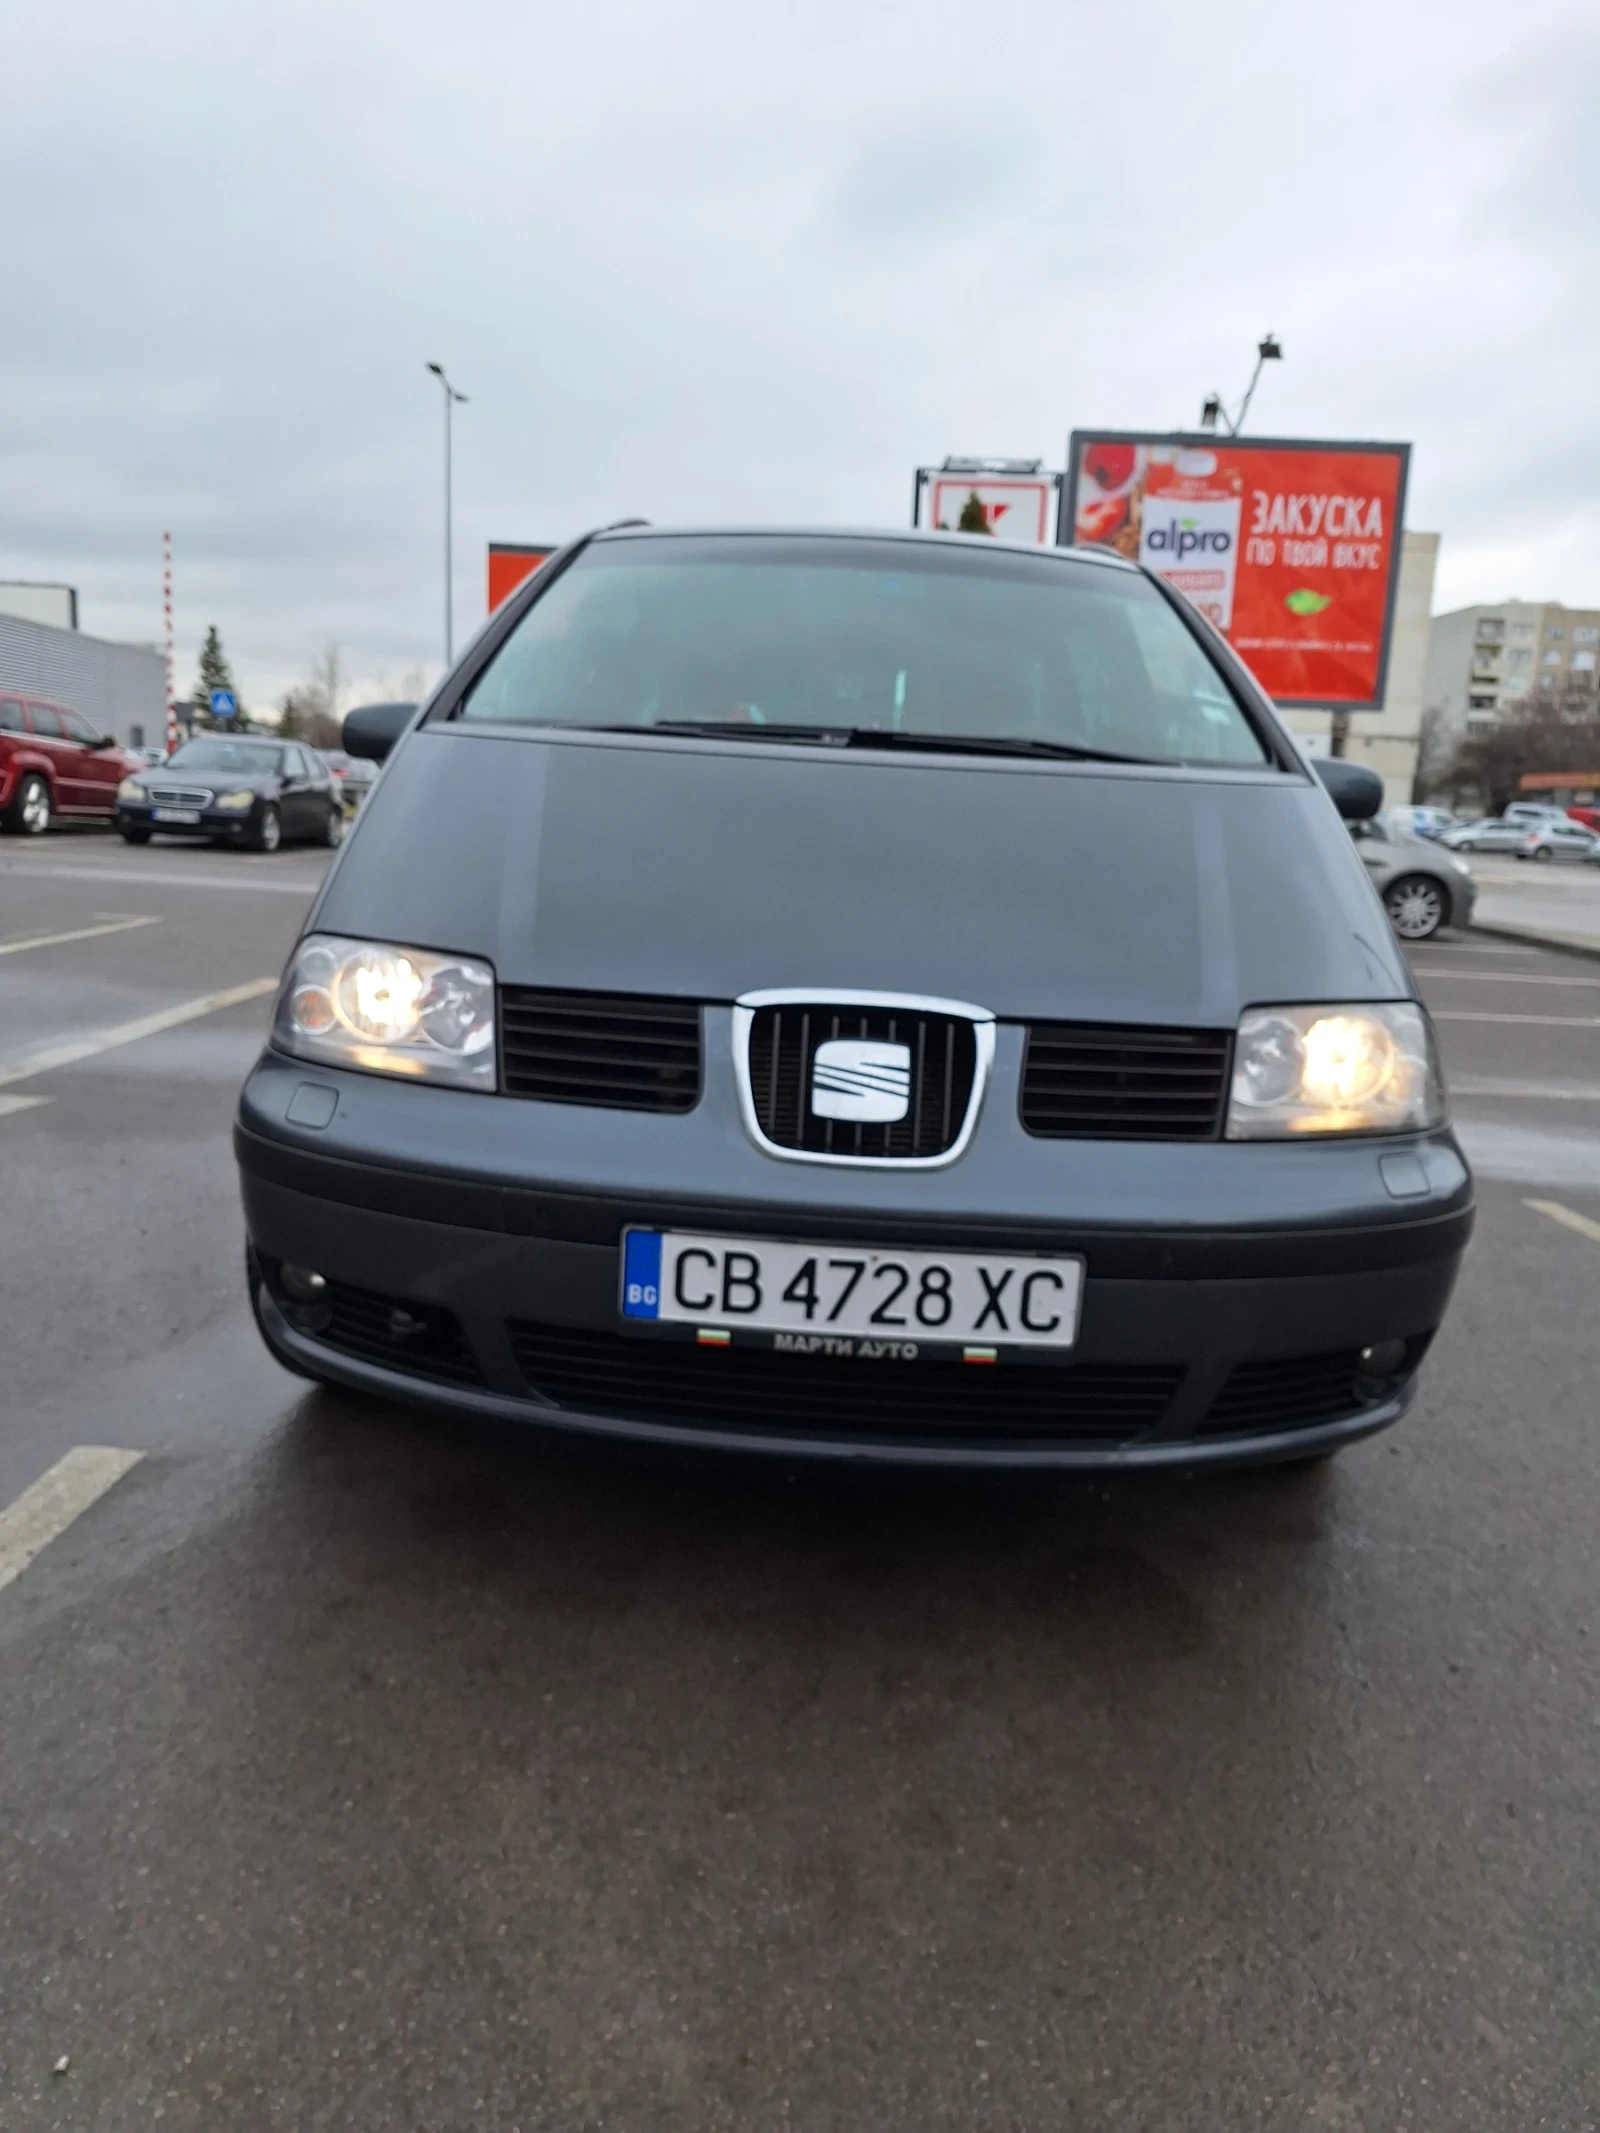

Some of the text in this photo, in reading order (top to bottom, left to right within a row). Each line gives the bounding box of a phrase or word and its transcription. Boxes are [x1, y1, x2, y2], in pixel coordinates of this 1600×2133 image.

[1251, 490, 1383, 538] ЗАКУСКА
[1147, 517, 1231, 561] alpro
[1245, 536, 1276, 566] ПО
[1332, 541, 1382, 570] ВКУС
[629, 1247, 1065, 1333] BG CB 4728 XC
[774, 1333, 919, 1360] МАРТИ АУТО
